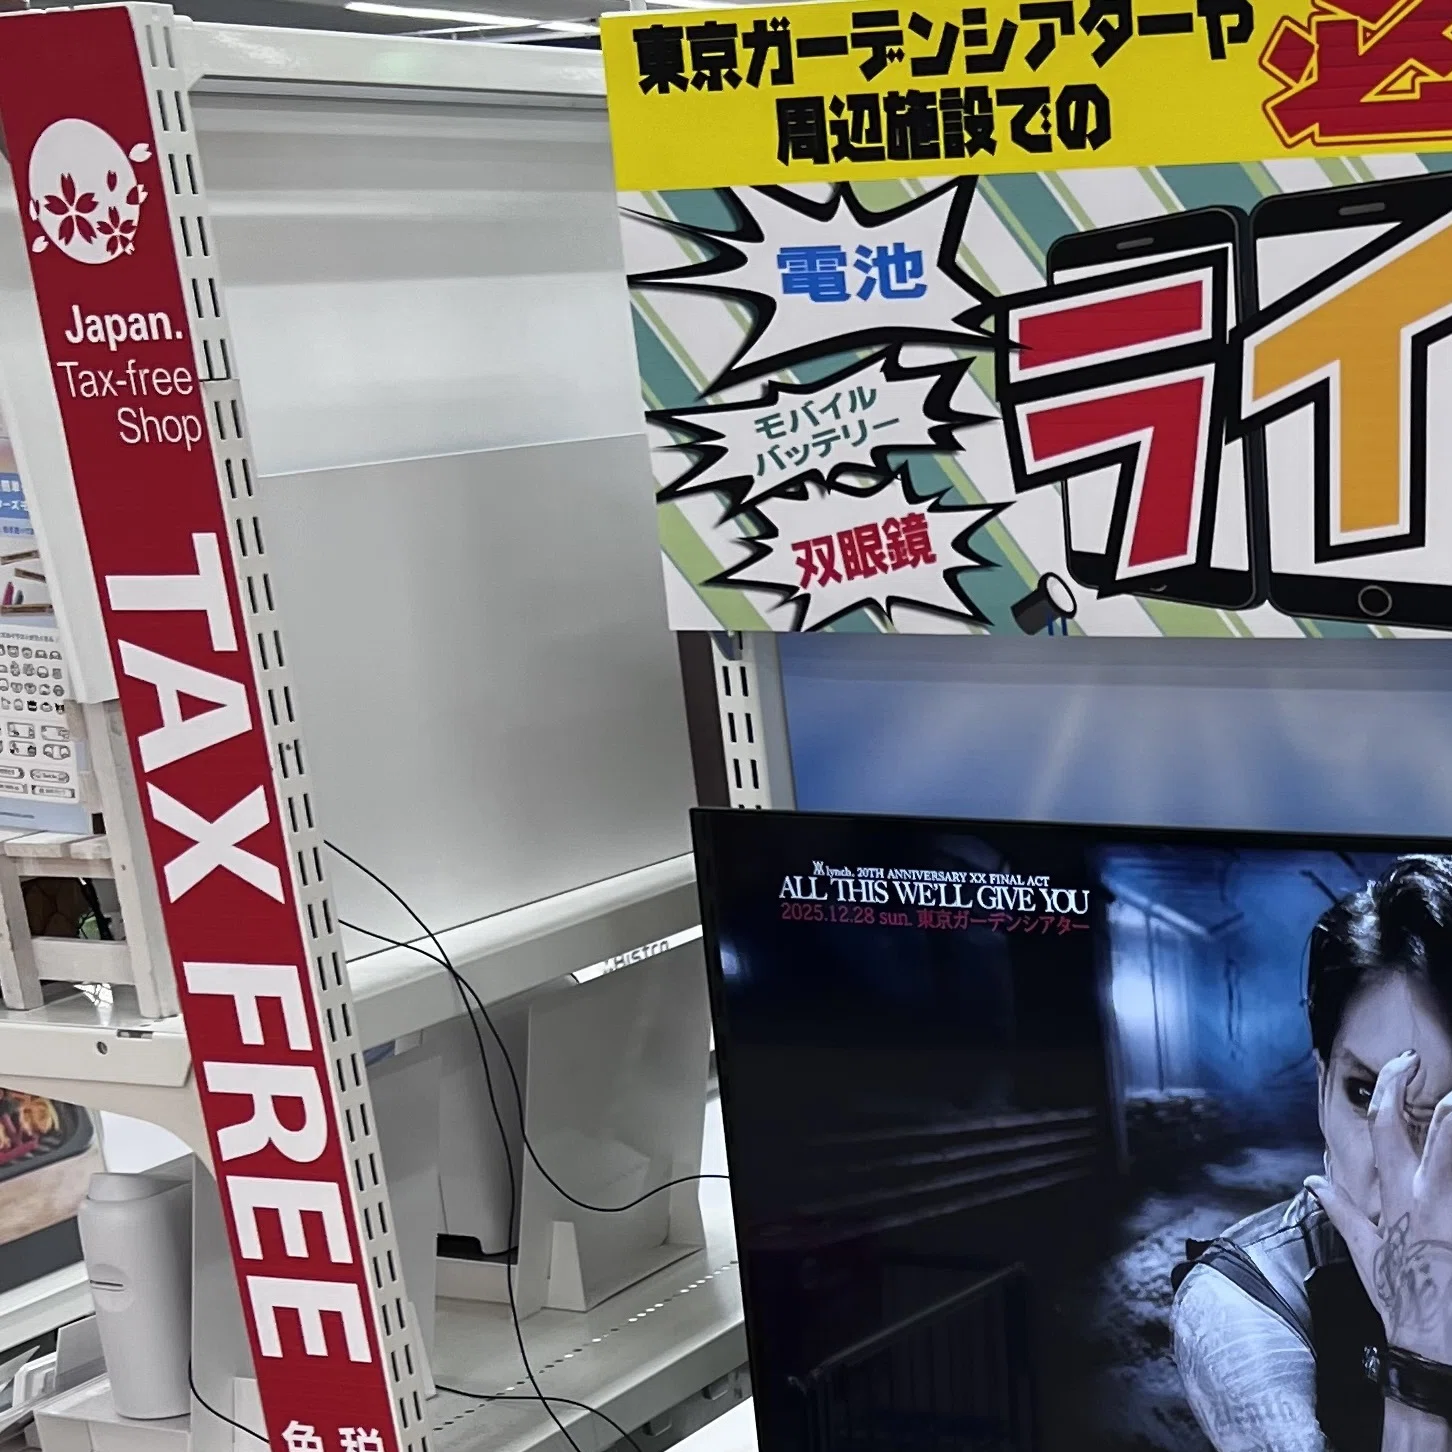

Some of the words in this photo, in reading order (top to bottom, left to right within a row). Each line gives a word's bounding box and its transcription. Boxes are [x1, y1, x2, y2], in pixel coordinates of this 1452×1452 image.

[632, 0, 1255, 94] 東京ガーデンシアターや
[775, 83, 1112, 167] 周辺施設での
[775, 242, 927, 303] 電池
[64, 305, 184, 351] Japan.
[57, 360, 194, 399] Tax-free
[118, 407, 203, 452] Shop
[754, 384, 877, 440] モバイル
[756, 417, 900, 476] バッテリー
[790, 513, 937, 590] 双眼鏡
[105, 532, 285, 904] TAX
[779, 875, 829, 900] ALL
[830, 878, 890, 904] THIS
[891, 880, 973, 908] WE'LL
[976, 885, 1037, 912] GIVE
[1038, 887, 1091, 915] YOU
[856, 867, 884, 879] 20TH
[887, 868, 968, 883] ANNIVERSARY
[969, 872, 987, 884] XX
[989, 873, 1026, 886] FINAL
[1026, 876, 1051, 887] ACT
[780, 901, 876, 925] 2025.12.28
[878, 911, 914, 926] sun.
[916, 908, 1091, 936] 東京ガーデンシアター
[183, 961, 372, 1363] FREE
